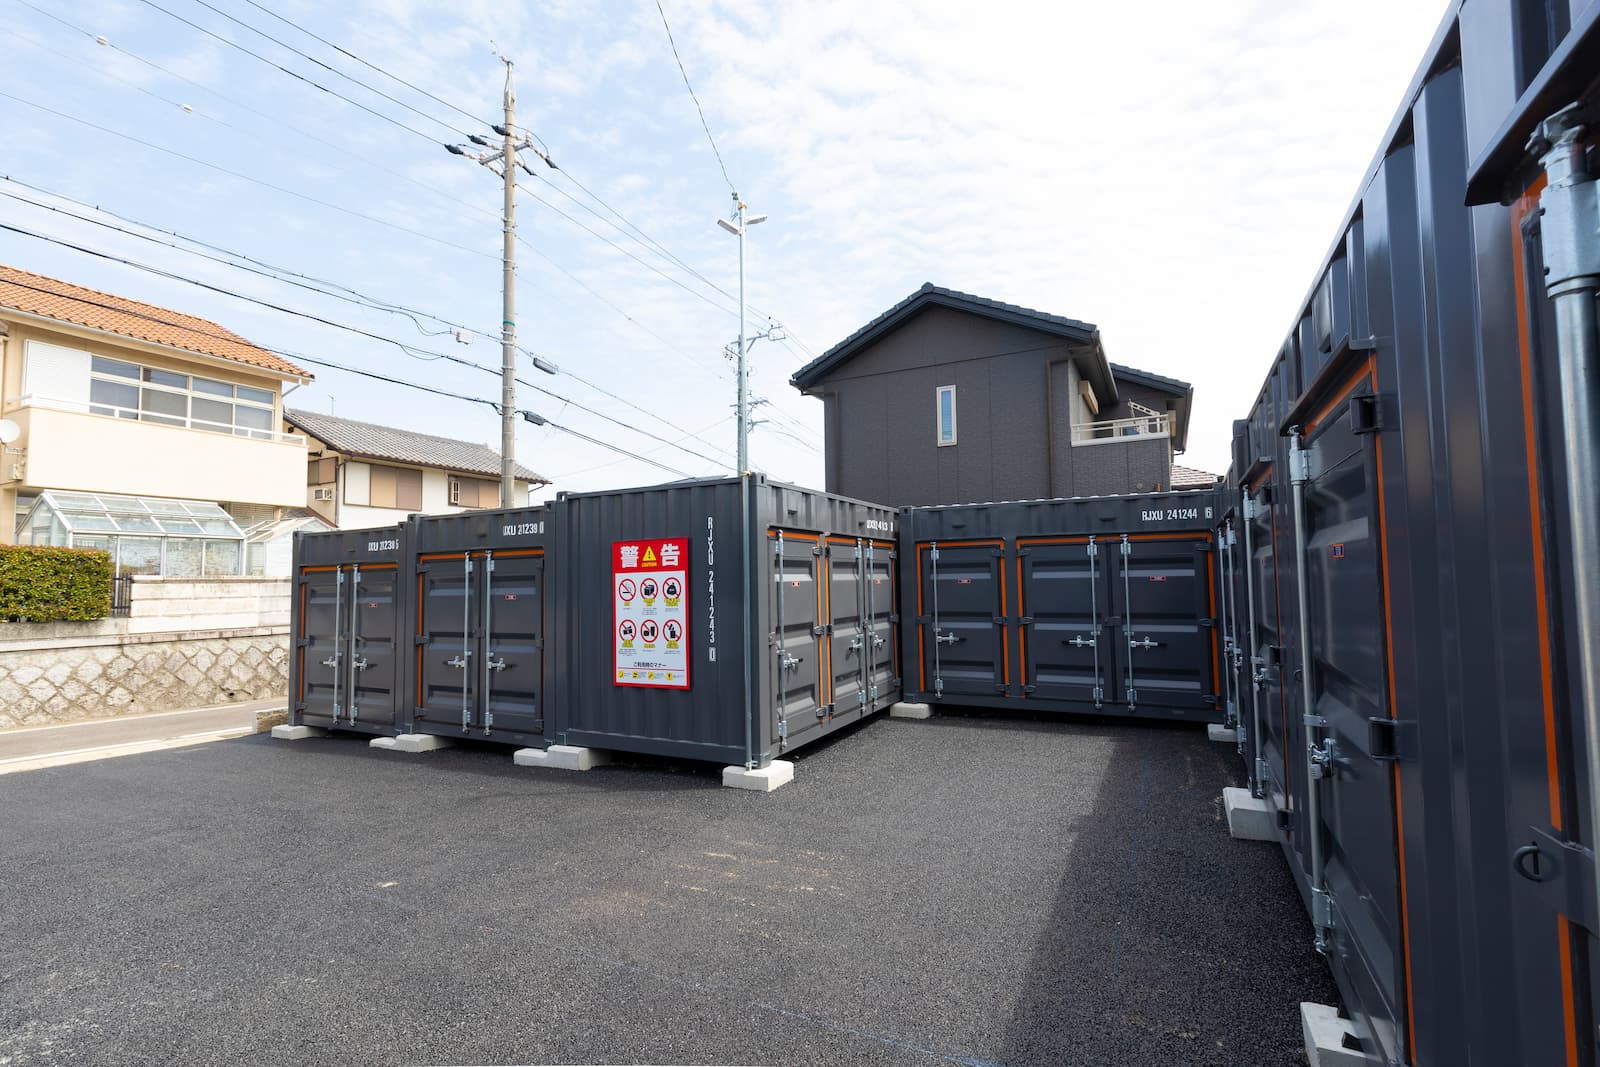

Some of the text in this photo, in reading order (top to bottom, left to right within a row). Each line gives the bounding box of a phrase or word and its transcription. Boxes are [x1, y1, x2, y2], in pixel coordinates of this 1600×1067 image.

[1142, 507, 1213, 521] RJXU 241244 6
